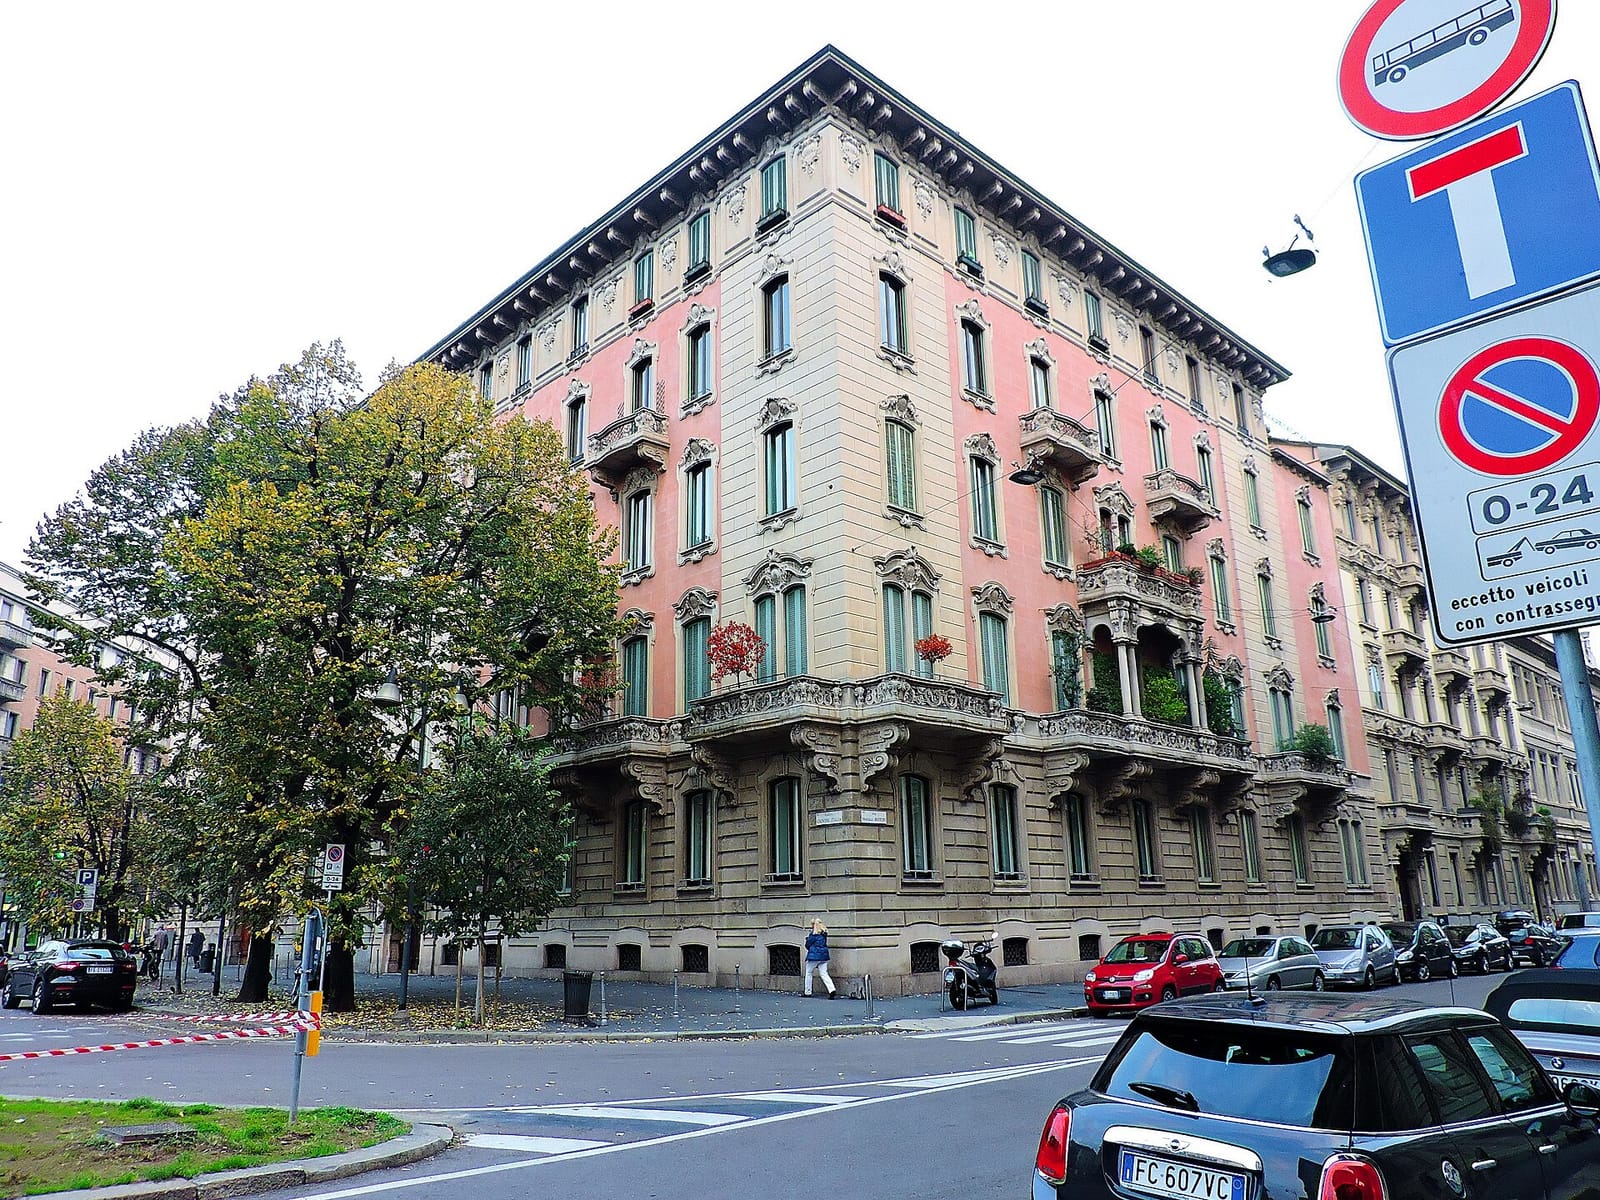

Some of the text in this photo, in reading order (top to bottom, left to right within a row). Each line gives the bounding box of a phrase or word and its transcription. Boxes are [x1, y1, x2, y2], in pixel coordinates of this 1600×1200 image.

[1482, 474, 1595, 525] 0-24
[1451, 568, 1589, 610] eccetto veicoli
[1455, 616, 1485, 632] con
[82, 871, 92, 883] P
